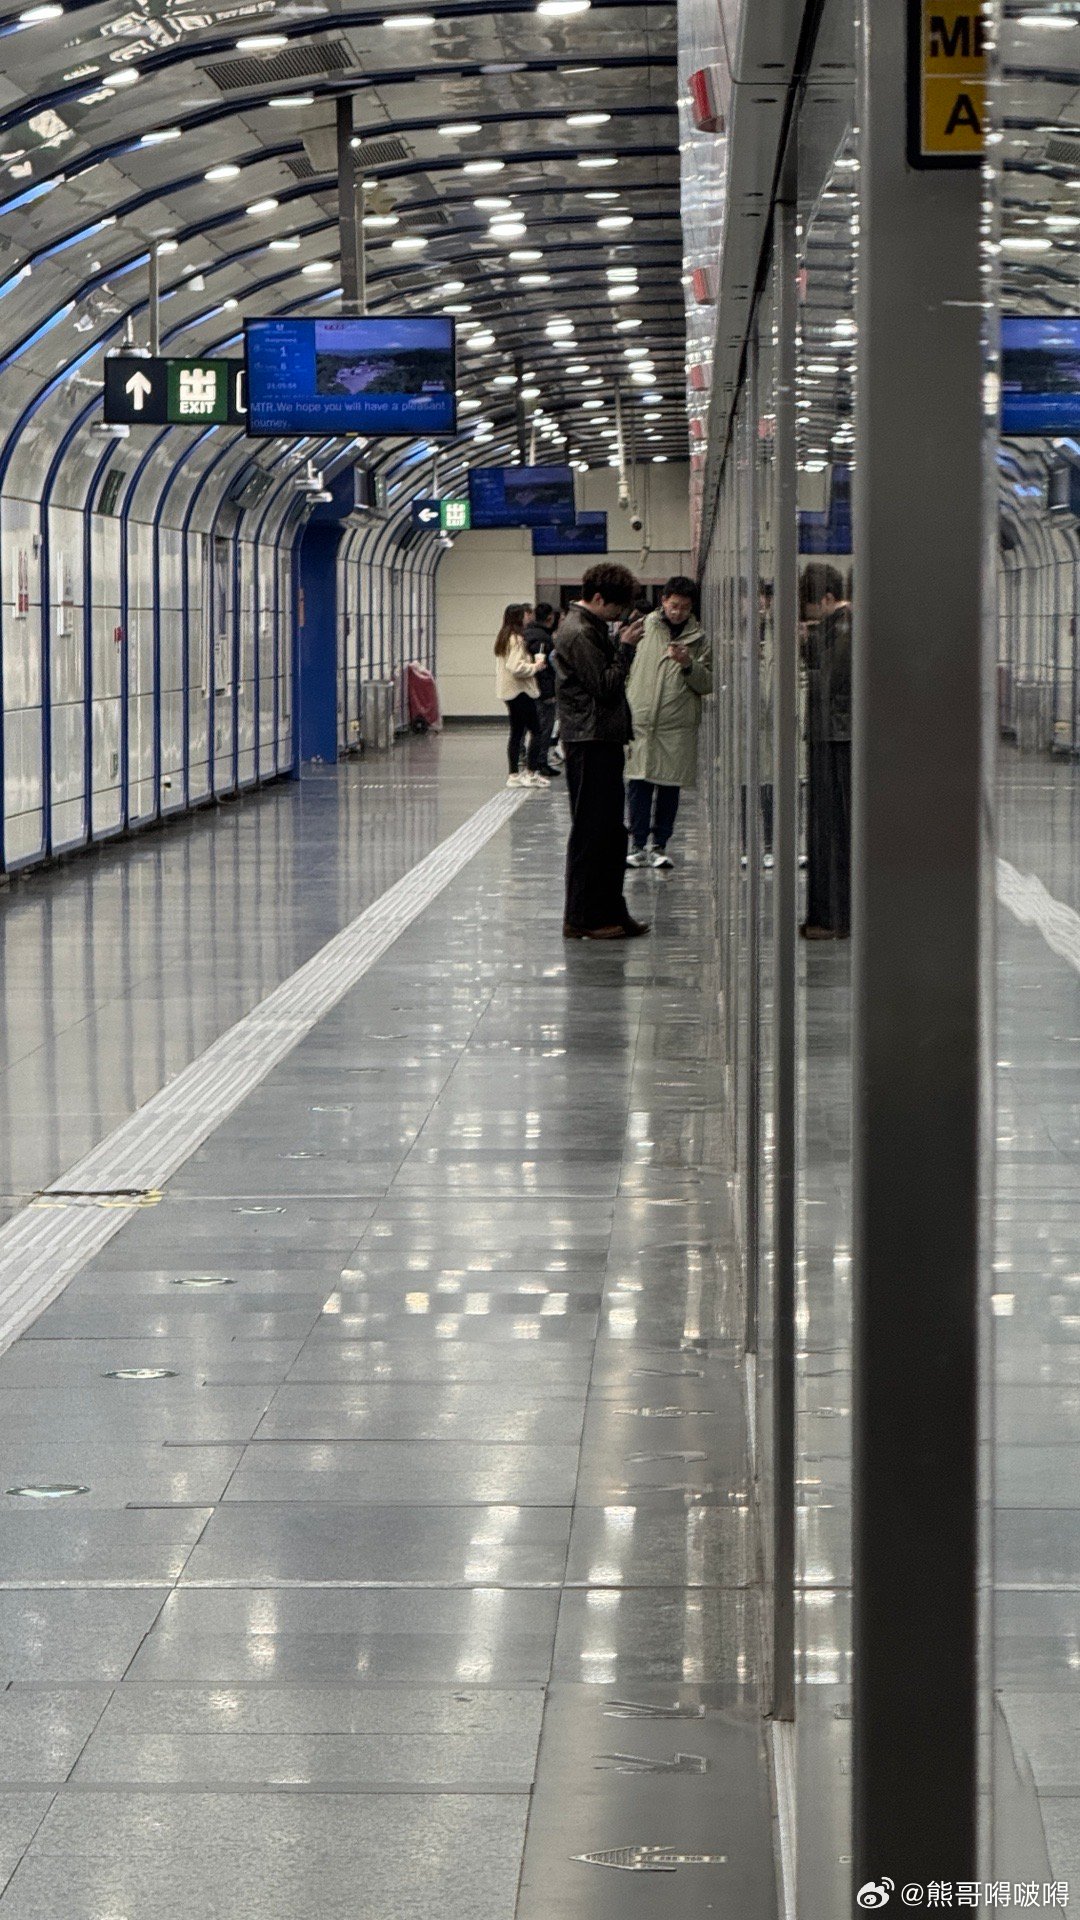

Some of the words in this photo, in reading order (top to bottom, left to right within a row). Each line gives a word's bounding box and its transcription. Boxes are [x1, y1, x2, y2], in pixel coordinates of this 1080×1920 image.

[944, 93, 982, 135] A
[180, 401, 216, 414] EXIT
[295, 402, 320, 413] hope
[324, 404, 342, 414] you
[345, 402, 362, 411] will
[365, 402, 388, 411] have
[391, 403, 399, 411] a
